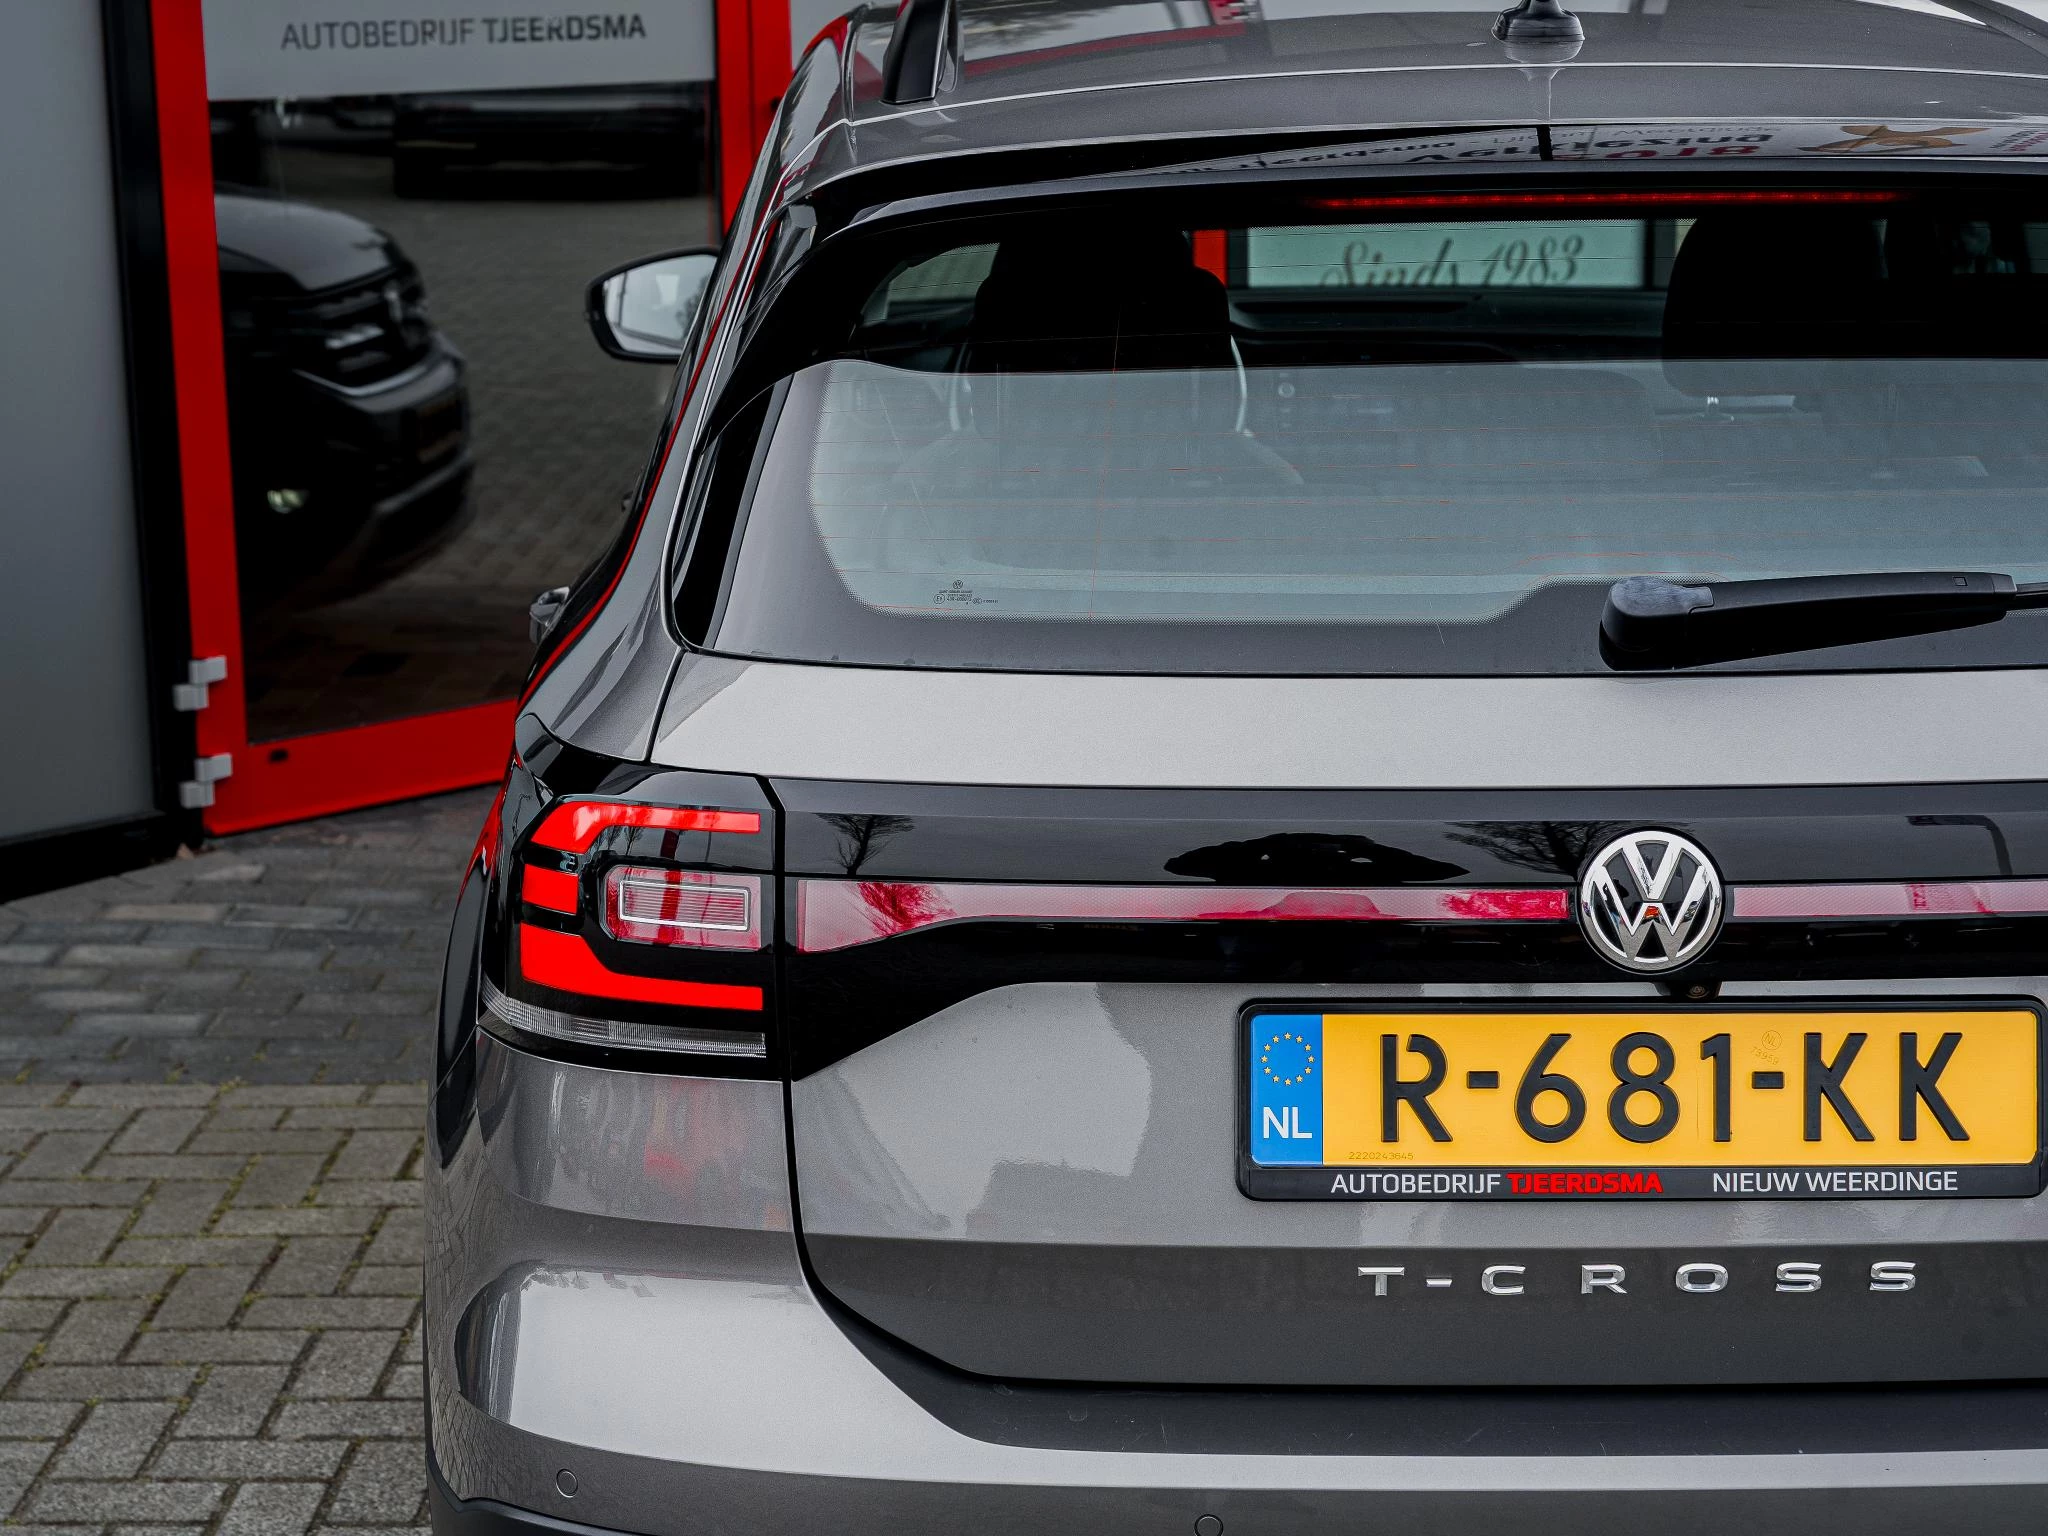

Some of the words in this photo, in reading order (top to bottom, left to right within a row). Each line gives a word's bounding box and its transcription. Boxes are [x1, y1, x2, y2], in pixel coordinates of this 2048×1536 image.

[281, 17, 476, 50] AUTOBEDRIJF
[482, 13, 647, 44] TJEERDSMA
[1319, 237, 1459, 287] Sinds
[1482, 234, 1584, 287] 1983
[1380, 1031, 1971, 1144] R-681-KK
[1262, 1106, 1313, 1139] NL
[1330, 1173, 1501, 1194] AUTOBEDRIJF
[1507, 1172, 1664, 1194] TJEERDSMA
[1713, 1172, 1800, 1193] NIEUW
[1805, 1171, 1959, 1192] WEERDINGE
